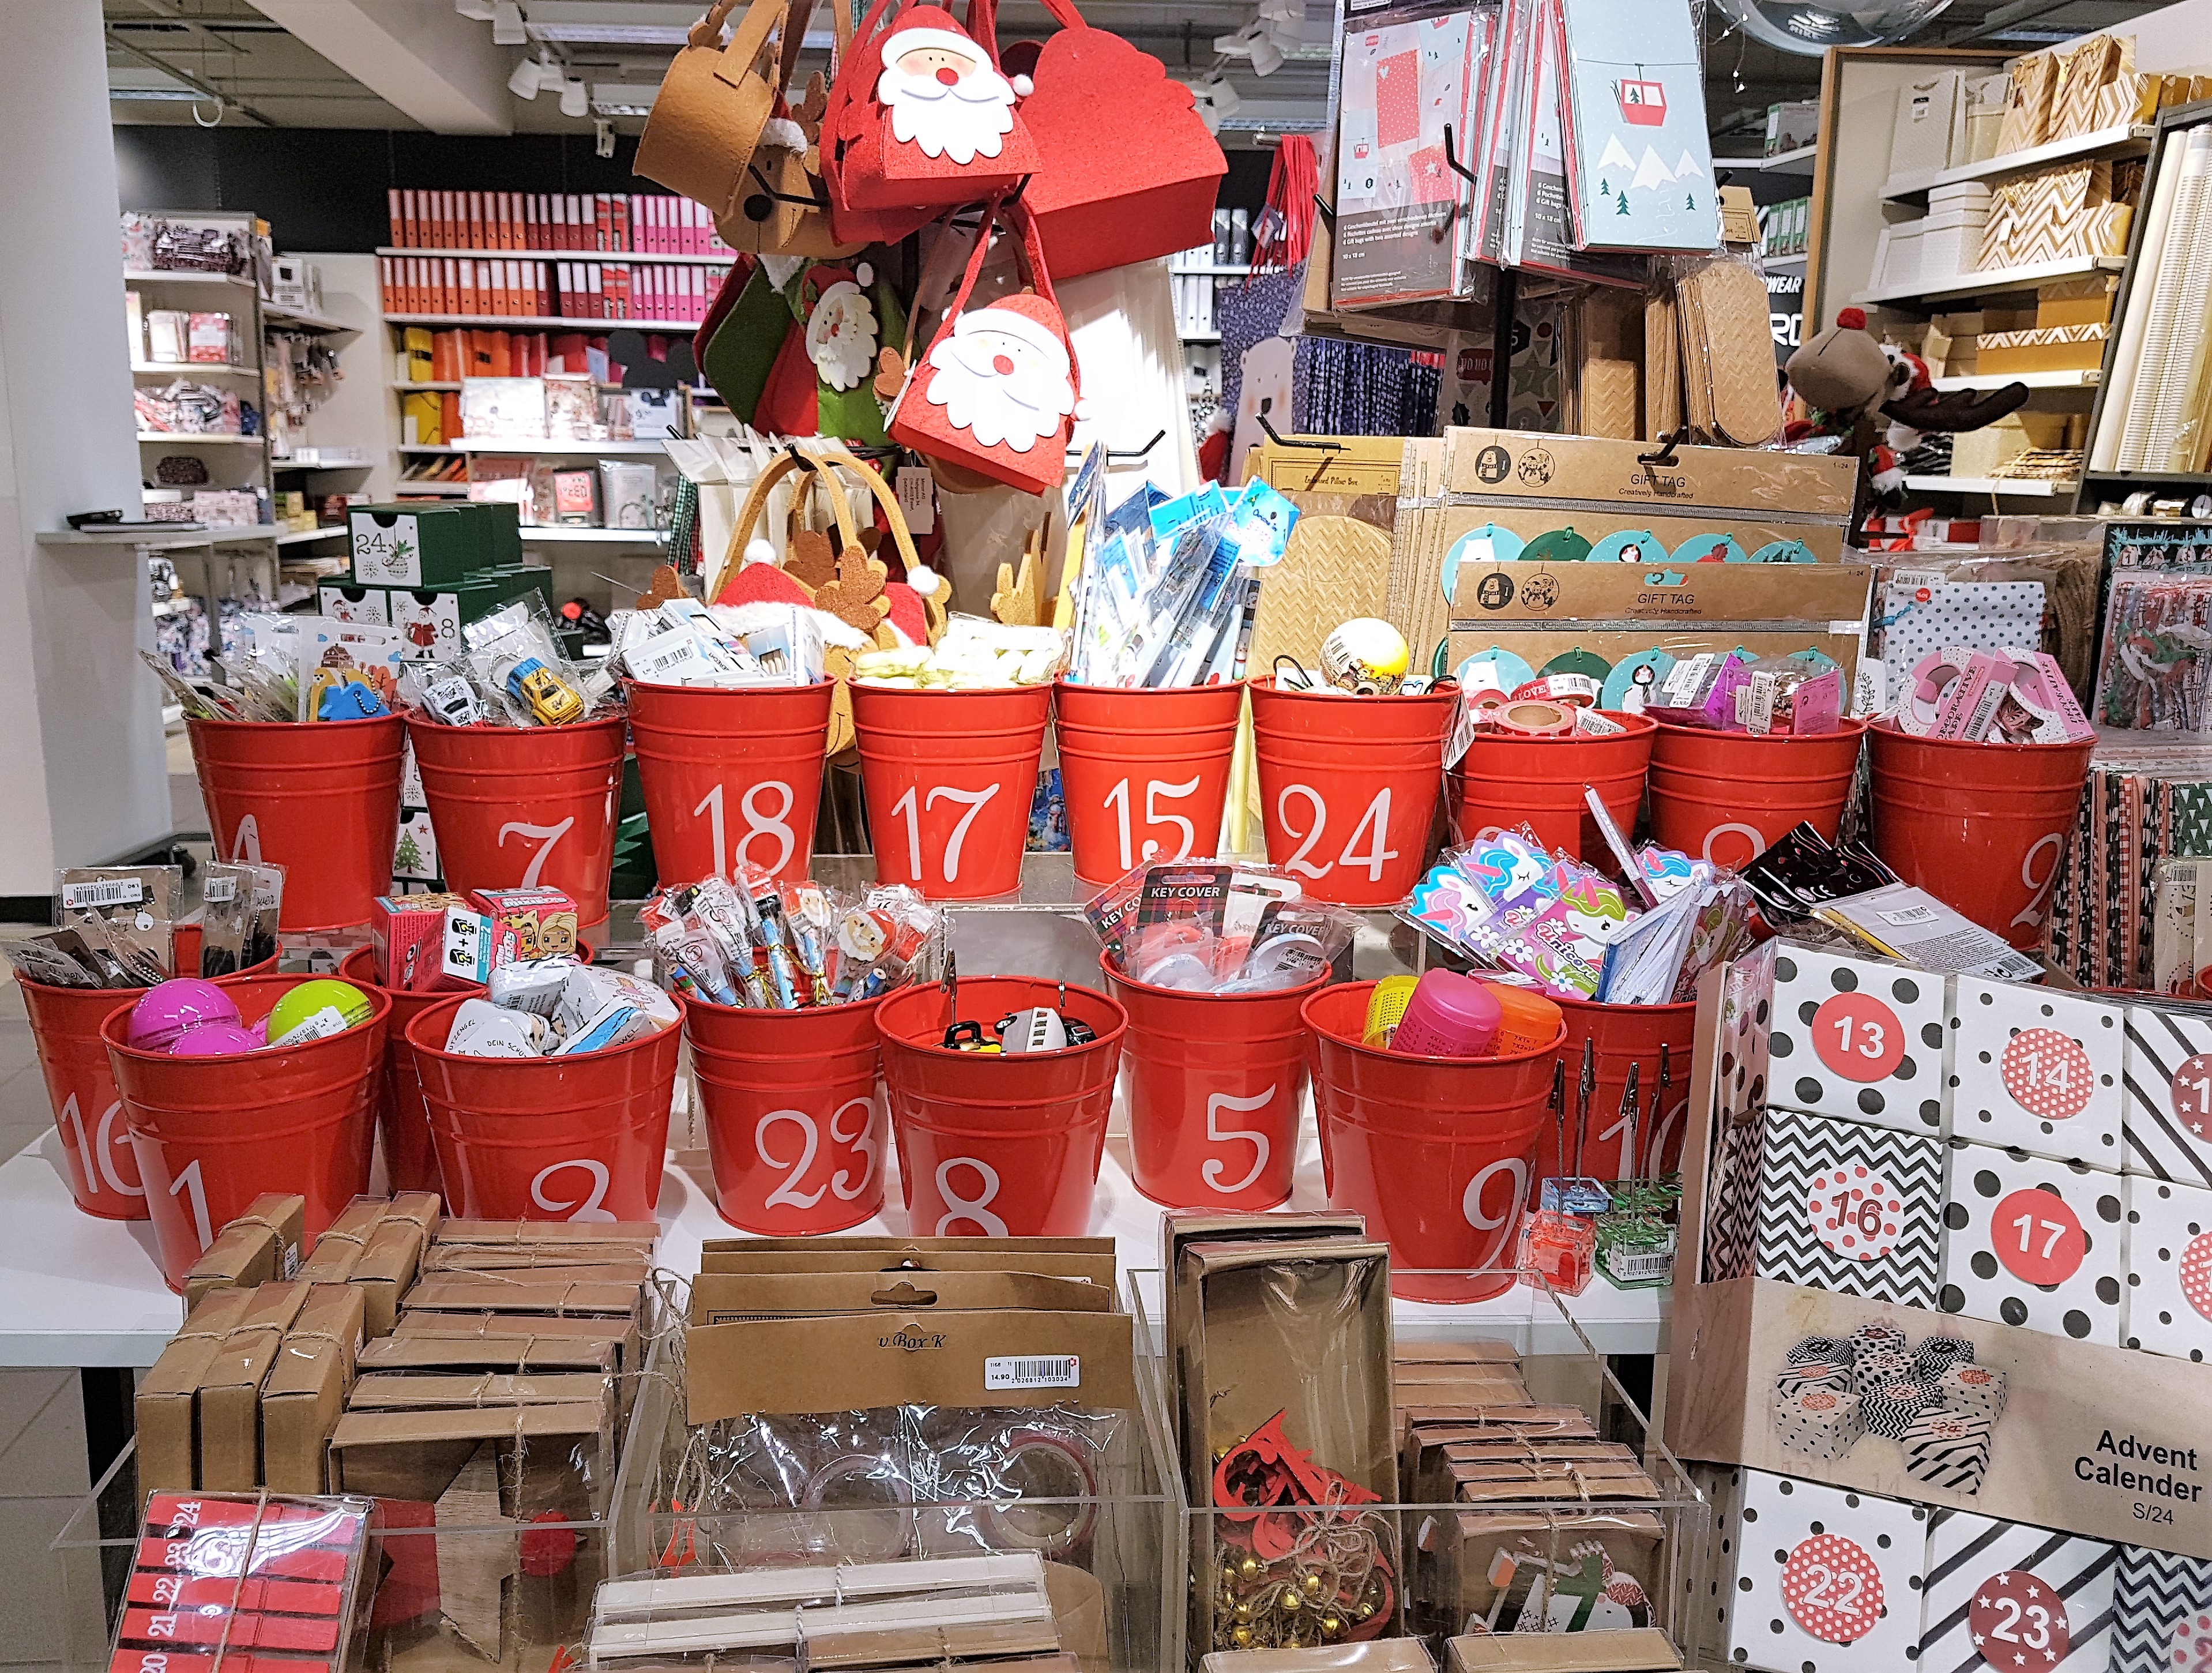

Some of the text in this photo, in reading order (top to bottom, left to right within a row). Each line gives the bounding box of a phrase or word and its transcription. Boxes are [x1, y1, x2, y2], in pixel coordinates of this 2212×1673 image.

[1766, 276, 1801, 293] WEAR
[1619, 488, 1652, 497] Creatively
[1631, 474, 1686, 487] GIFT TAG
[356, 533, 387, 555] 24
[1638, 593, 1694, 604] GIFT TAG
[441, 618, 456, 640] 8
[1936, 665, 1977, 739] DECORATIVE
[694, 781, 795, 877] 18
[891, 783, 999, 883] 17
[1104, 775, 1201, 870] 15
[1278, 784, 1398, 882] 24
[498, 816, 574, 890] 7
[1151, 886, 1220, 898] KEY COVER
[1101, 907, 1123, 930] KEY
[1266, 923, 1326, 937] KEY COVER
[1536, 923, 1600, 983] Unicorn
[487, 1039, 505, 1047] DEIN
[1834, 1015, 1886, 1059] 13
[2020, 1051, 2071, 1096] 14
[2192, 1077, 2210, 1114] 1
[62, 1092, 142, 1196] 16
[755, 1097, 878, 1210] 23
[1202, 1083, 1276, 1193] 5
[170, 1159, 214, 1253] 1
[935, 1157, 1009, 1236] 8
[1462, 1157, 1529, 1280] 9
[1831, 1190, 1883, 1236] 16
[2012, 1213, 2066, 1260] 17
[893, 1333, 928, 1349] Box
[2096, 1430, 2198, 1472] Advent
[2075, 1456, 2202, 1502] Calender
[172, 1501, 202, 1526] 24
[2132, 1502, 2175, 1525] S/24
[152, 1577, 182, 1602] 22
[1802, 1564, 1864, 1618] 22
[147, 1613, 178, 1637] 21
[1990, 1597, 2051, 1649] 23
